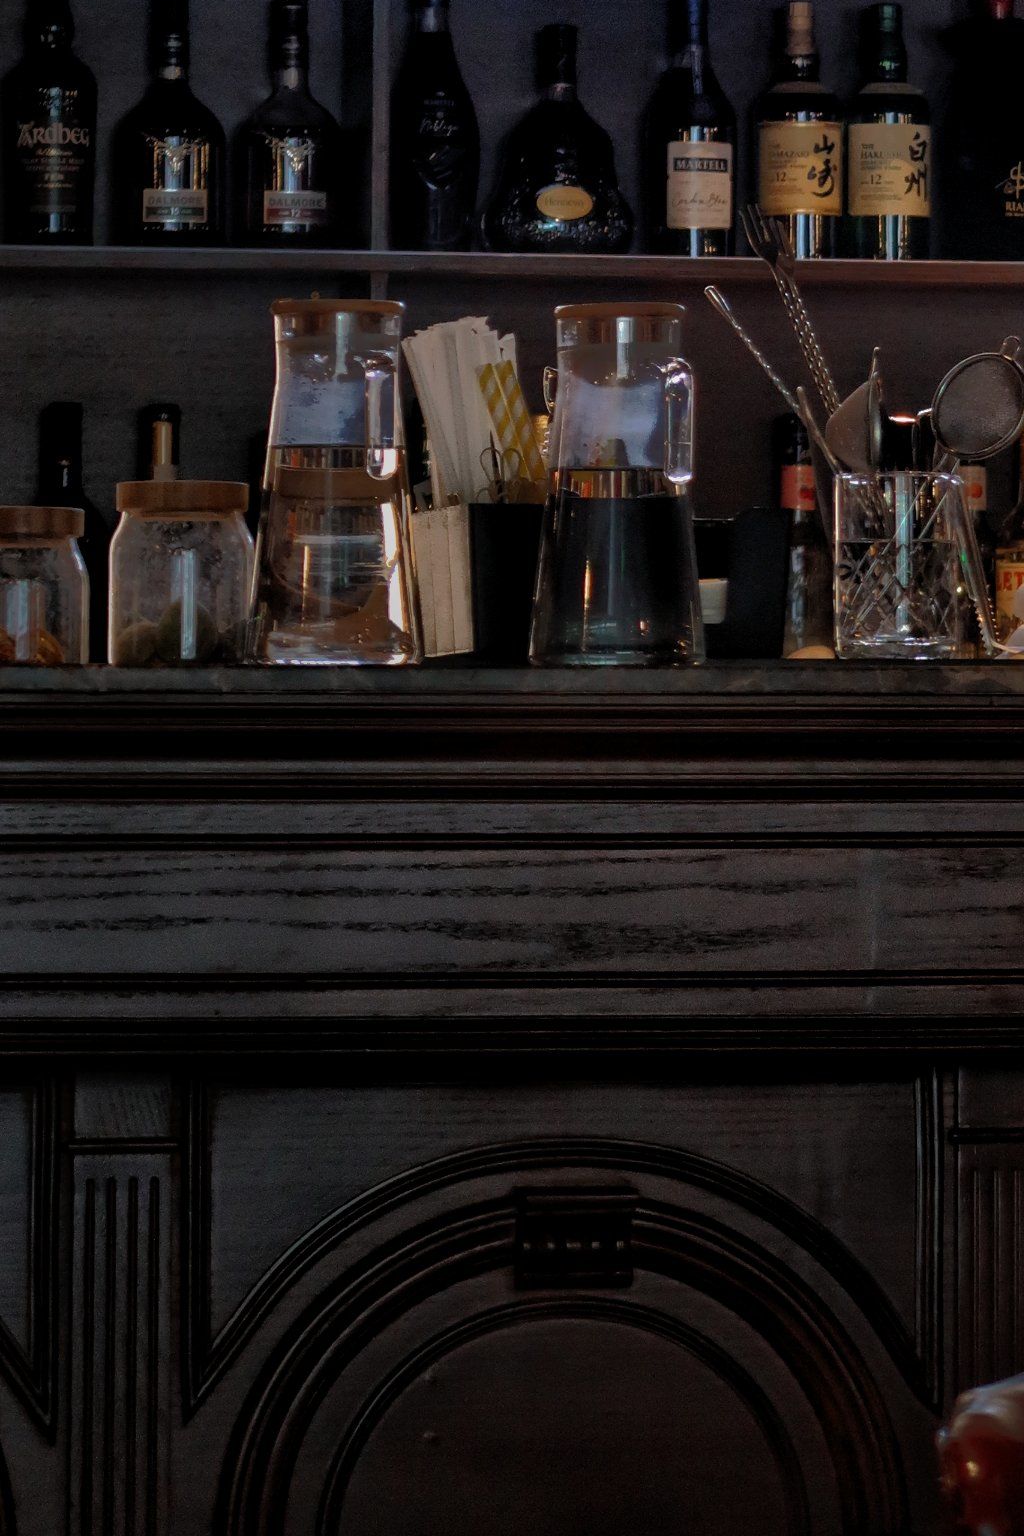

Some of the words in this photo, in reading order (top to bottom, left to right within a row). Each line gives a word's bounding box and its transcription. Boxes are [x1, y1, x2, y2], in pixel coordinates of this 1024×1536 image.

[675, 159, 726, 171] MARTELL
[776, 171, 786, 182] 12
[870, 174, 882, 184] 12
[148, 196, 203, 206] DALMORE
